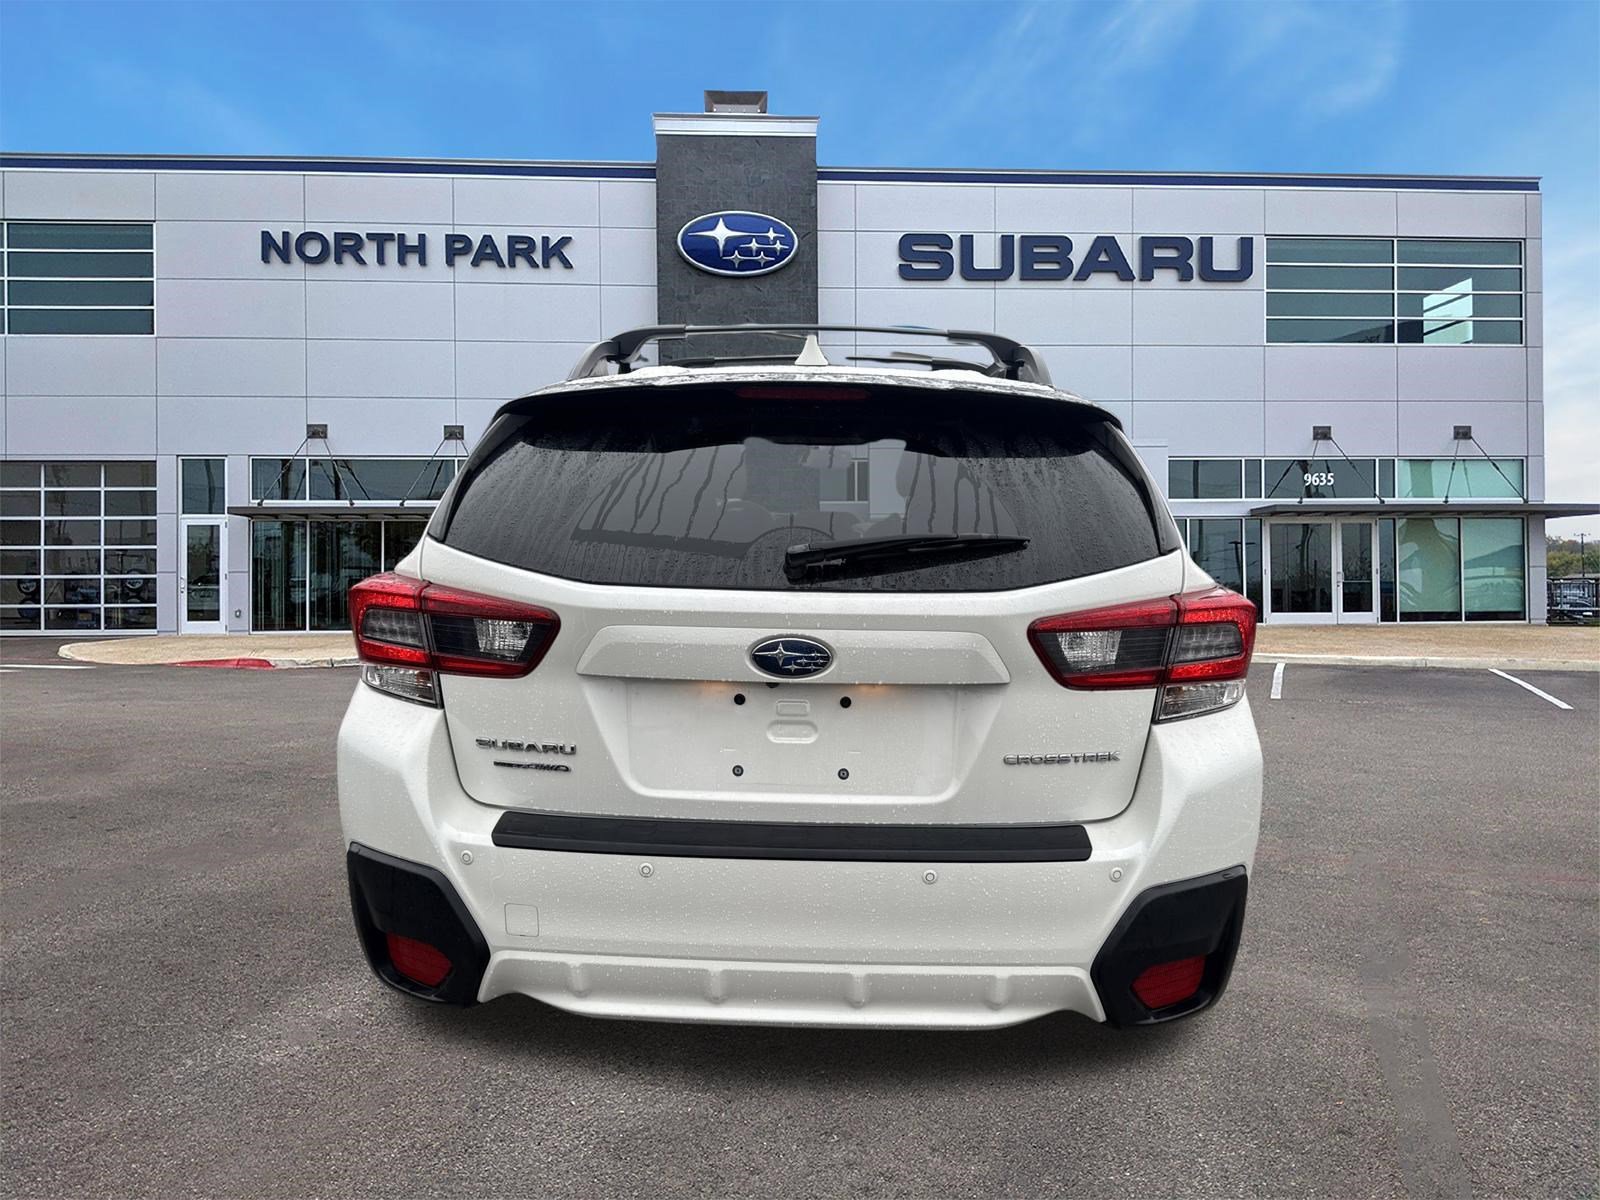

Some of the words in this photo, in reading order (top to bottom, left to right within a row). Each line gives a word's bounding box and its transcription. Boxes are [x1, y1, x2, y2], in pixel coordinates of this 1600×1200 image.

[261, 230, 427, 266] NORTH
[444, 233, 574, 269] PARK
[898, 233, 1254, 282] SUBARU
[1303, 472, 1335, 486] 9635
[475, 738, 577, 756] SUBARU
[1003, 751, 1121, 765] CROSSTREK
